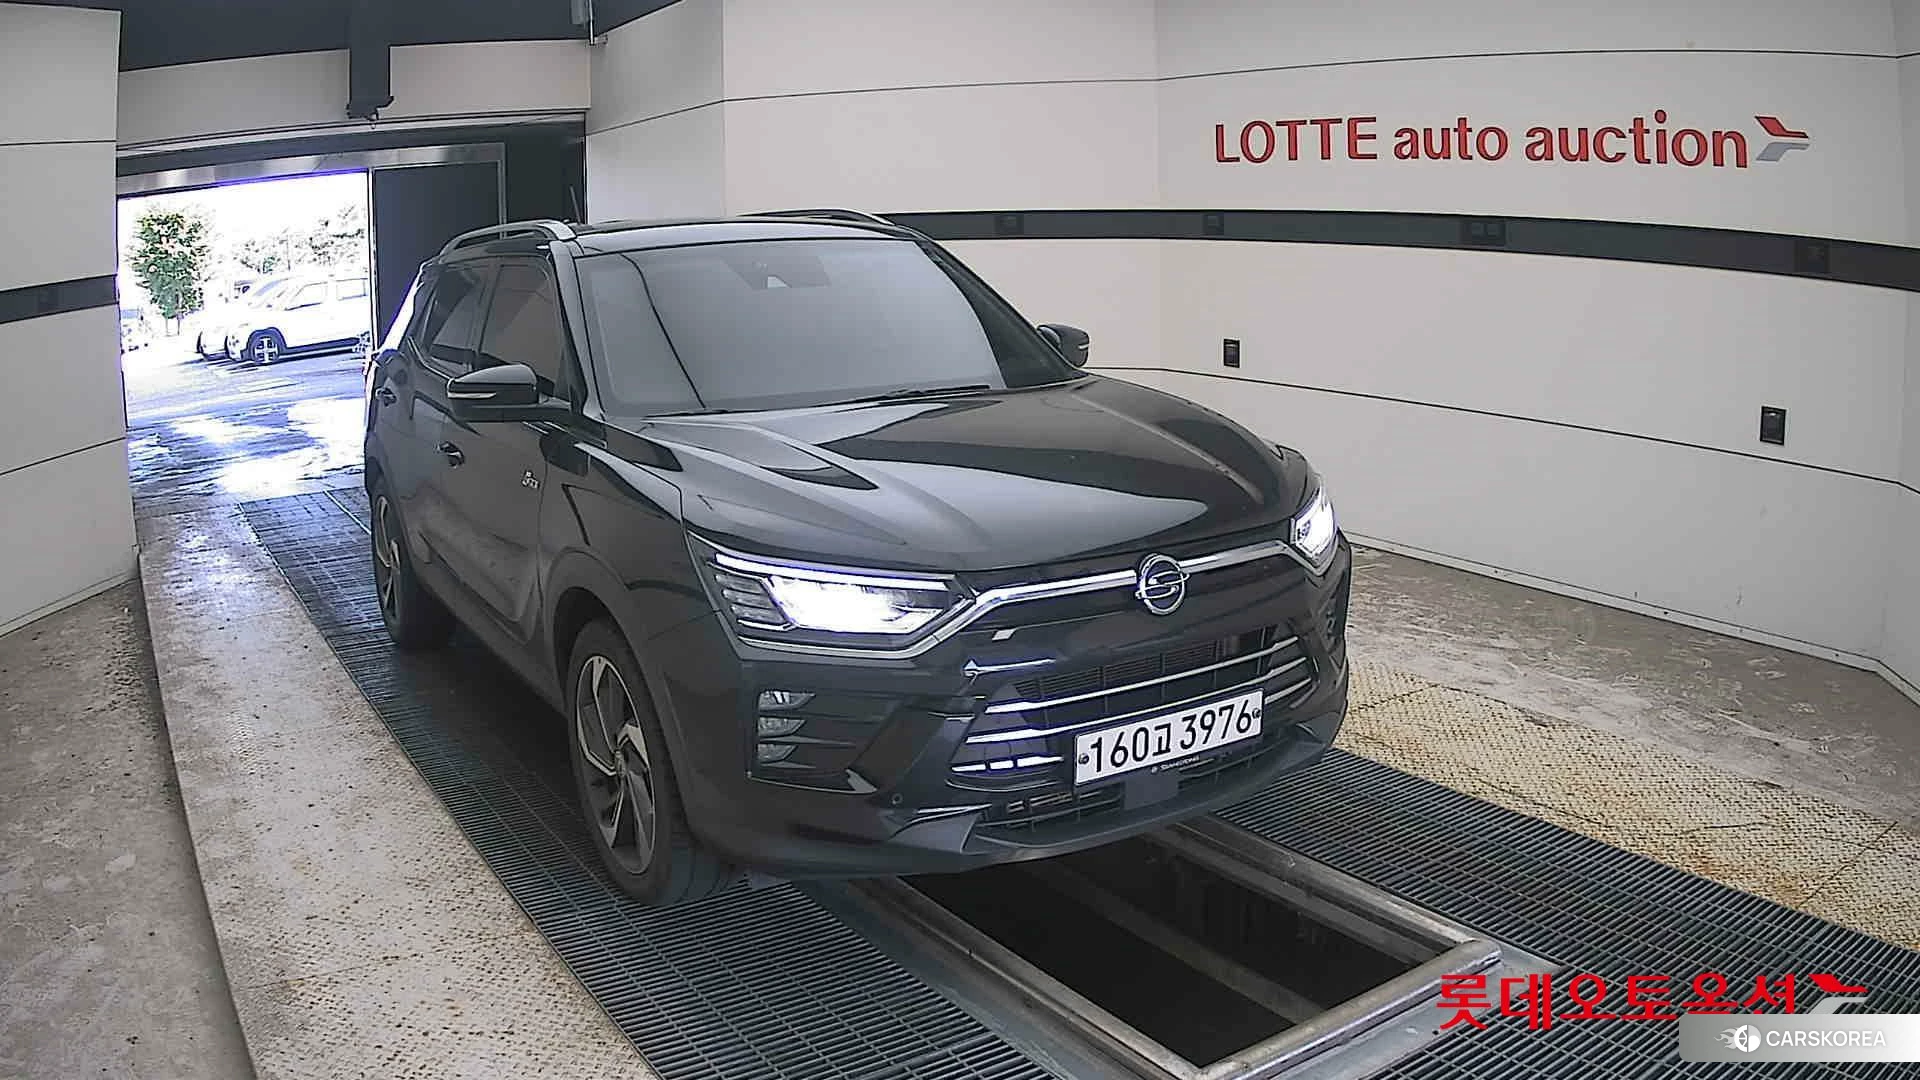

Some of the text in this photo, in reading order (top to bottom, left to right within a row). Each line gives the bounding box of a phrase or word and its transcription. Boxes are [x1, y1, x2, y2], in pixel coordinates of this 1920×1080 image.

[1215, 110, 1748, 168] LOTTE auto auction
[1090, 700, 1251, 773] 160고 3976
